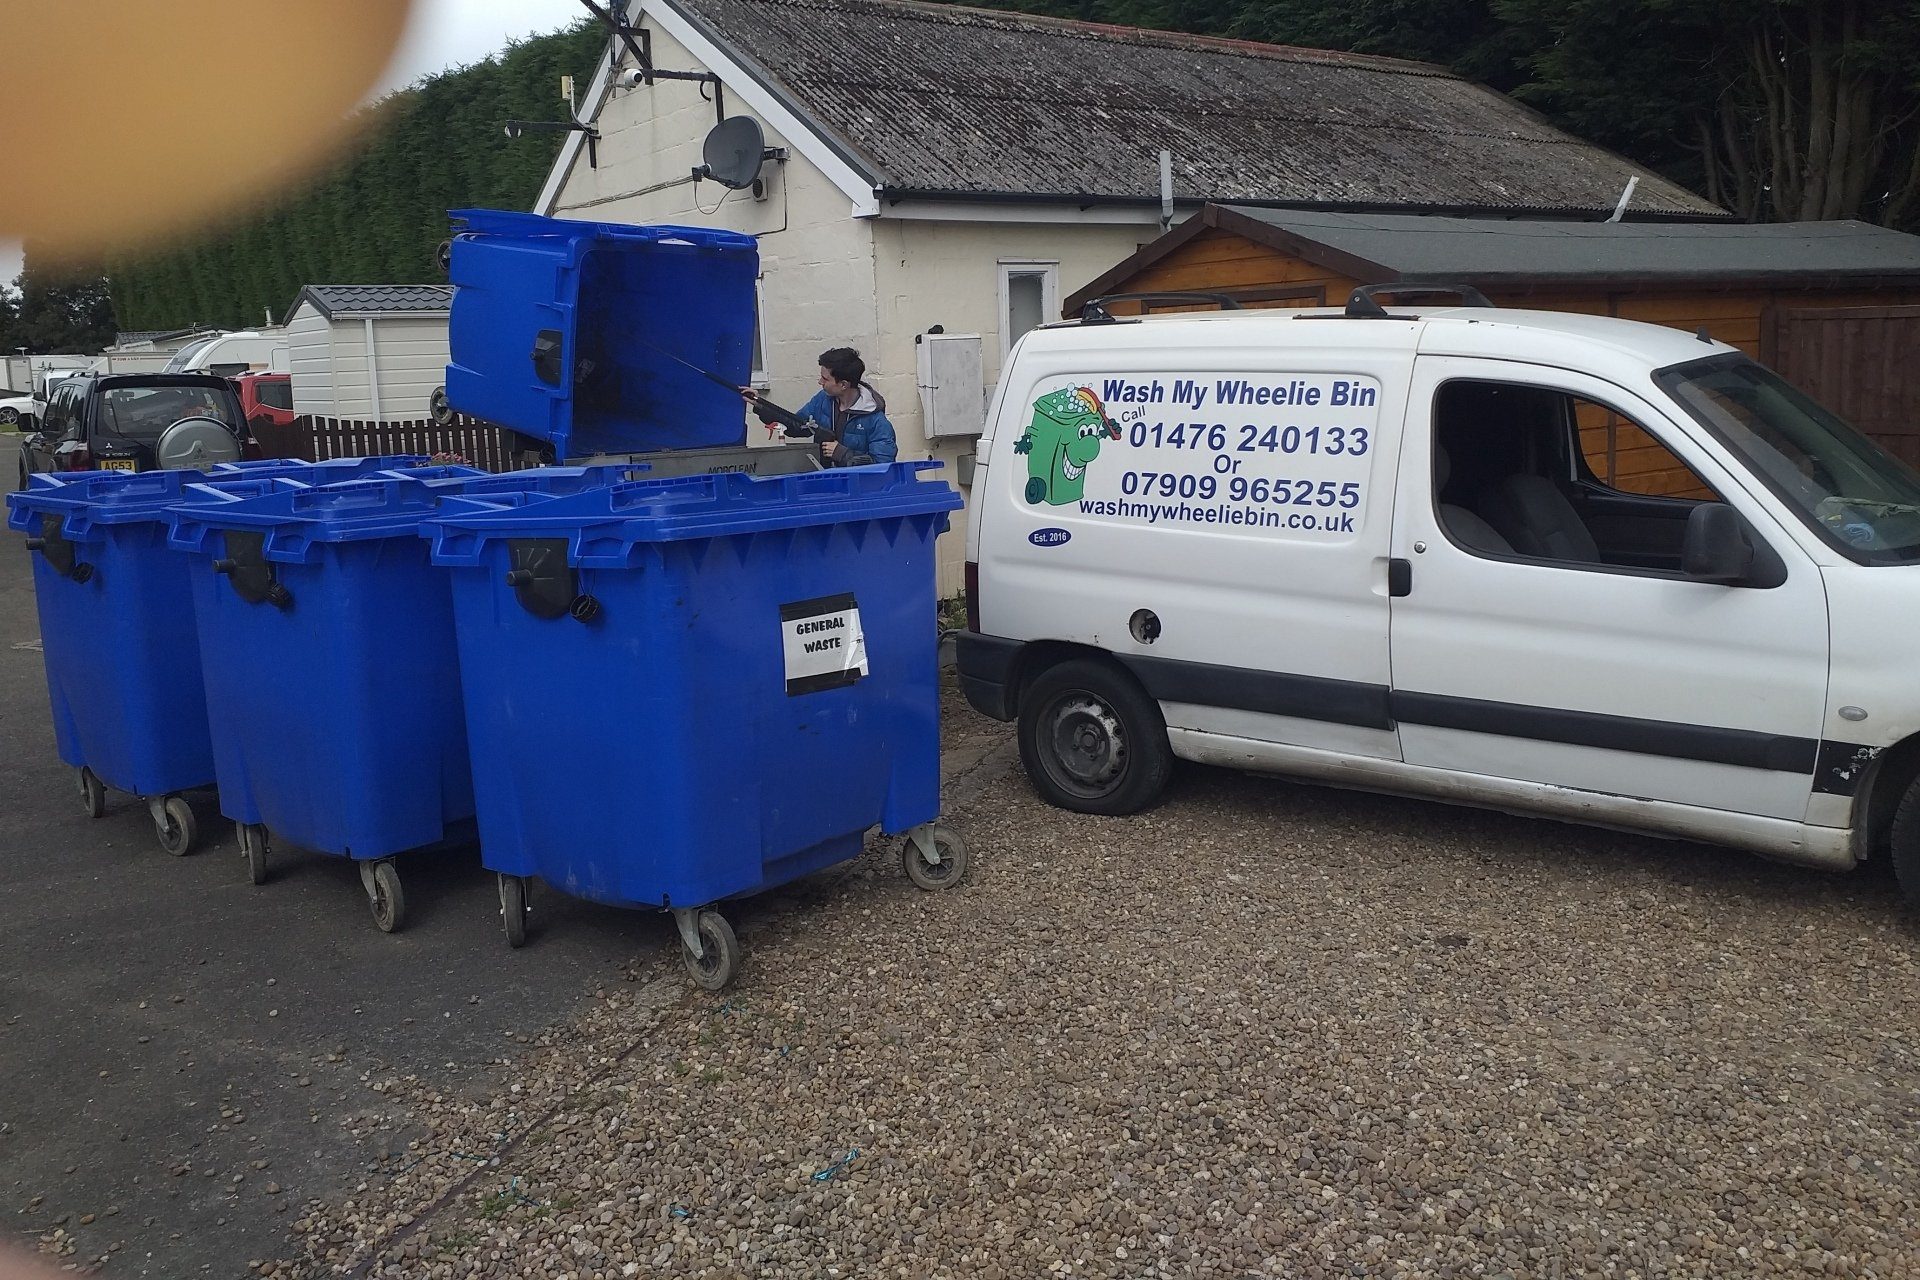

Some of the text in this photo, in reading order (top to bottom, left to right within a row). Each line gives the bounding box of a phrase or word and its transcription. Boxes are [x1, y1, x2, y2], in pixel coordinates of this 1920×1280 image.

[1103, 379, 1376, 411] Wash My Wheelie Bin
[1121, 405, 1146, 423] Call
[1129, 422, 1369, 456] 01476 240133
[105, 461, 132, 471] AG53
[1213, 454, 1242, 474] Or
[1121, 471, 1360, 509] 07909 965255
[1079, 498, 1354, 533] washmywheeliebin.co.uk
[1034, 531, 1067, 543] Est. 2016
[796, 617, 845, 635] GENERAL
[804, 637, 841, 653] WASTE
